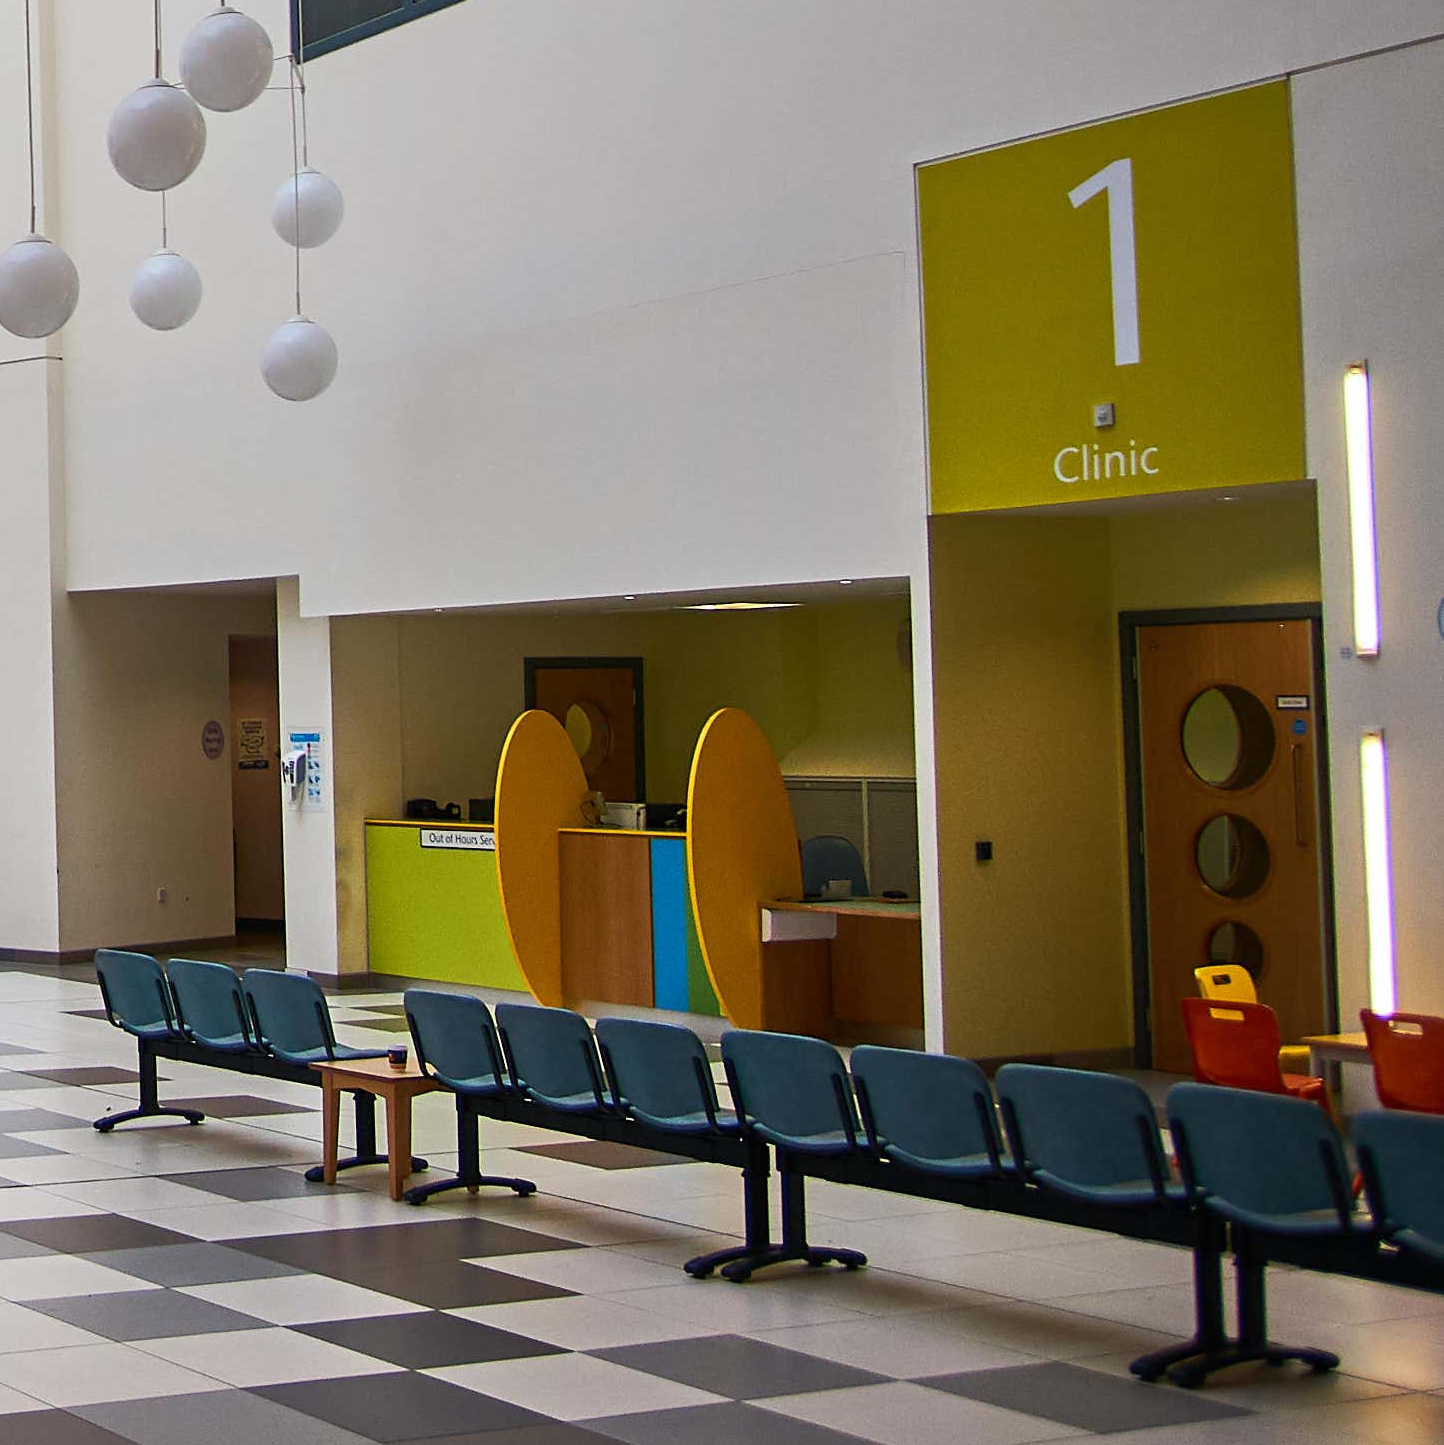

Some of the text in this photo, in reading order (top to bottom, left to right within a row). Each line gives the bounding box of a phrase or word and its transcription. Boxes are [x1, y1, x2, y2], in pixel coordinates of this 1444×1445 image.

[1067, 158, 1140, 366] 1
[1054, 439, 1159, 483] Clinic
[429, 832, 444, 843] Out
[445, 835, 453, 844] of
[455, 834, 478, 845] Hours
